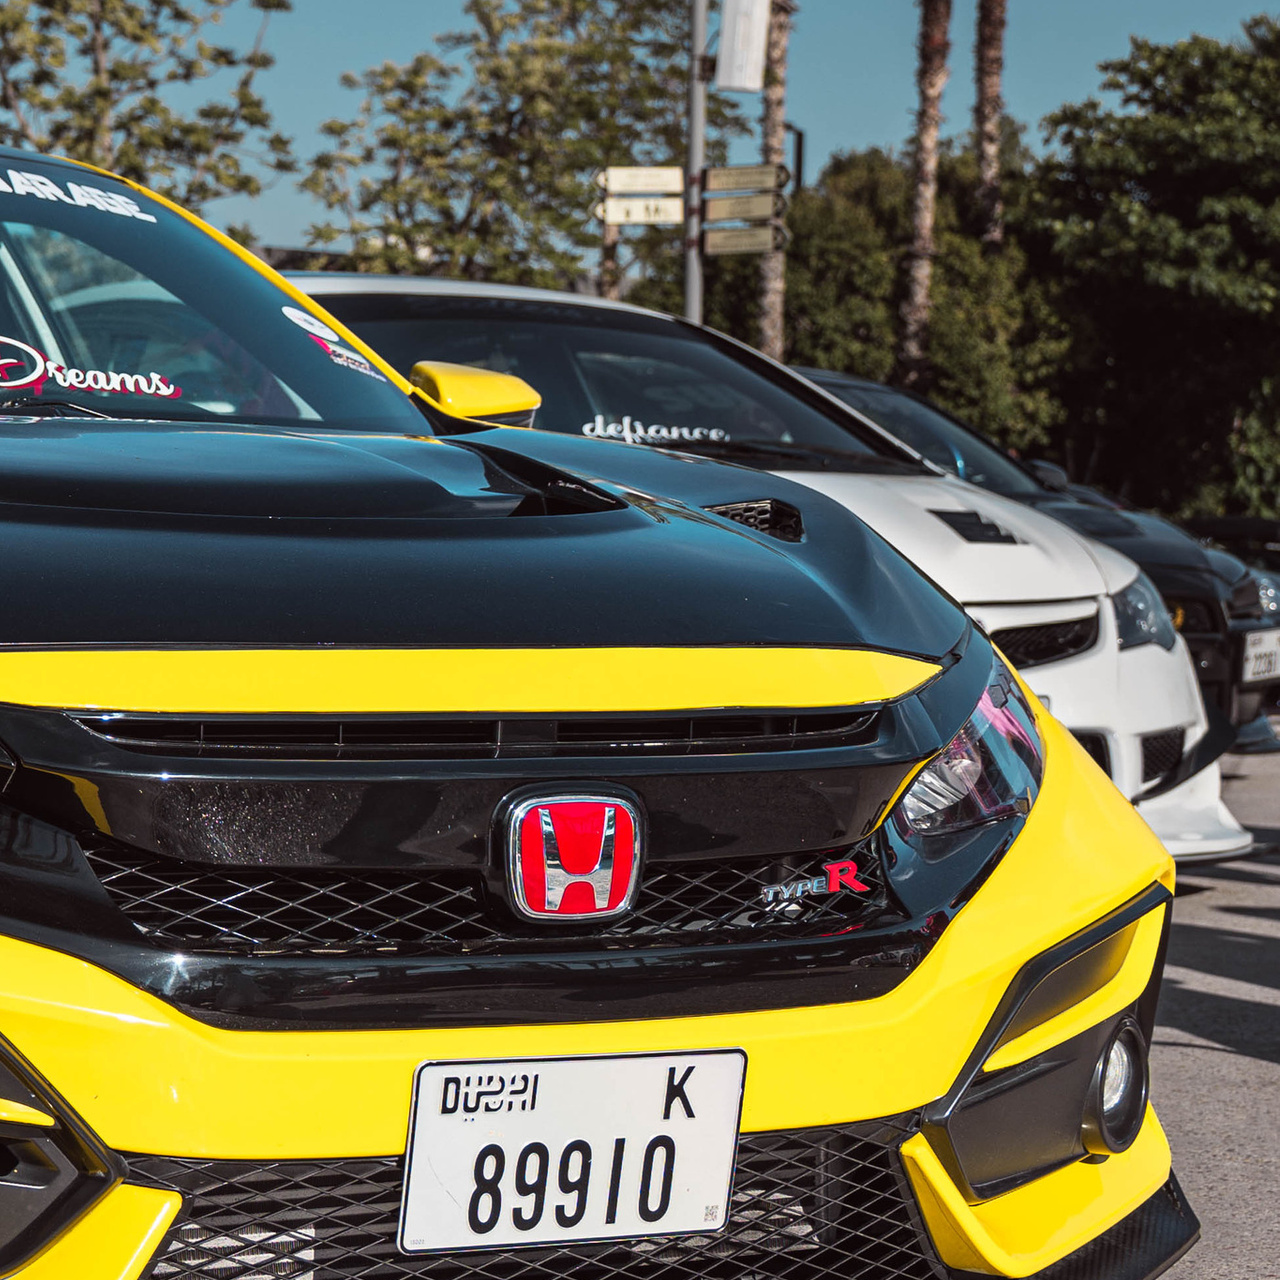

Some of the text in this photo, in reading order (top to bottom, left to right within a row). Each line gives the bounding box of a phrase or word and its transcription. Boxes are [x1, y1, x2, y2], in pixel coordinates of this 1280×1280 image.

[761, 876, 827, 903] TYPE
[662, 1066, 696, 1120] K
[467, 1134, 676, 1235] 89910
